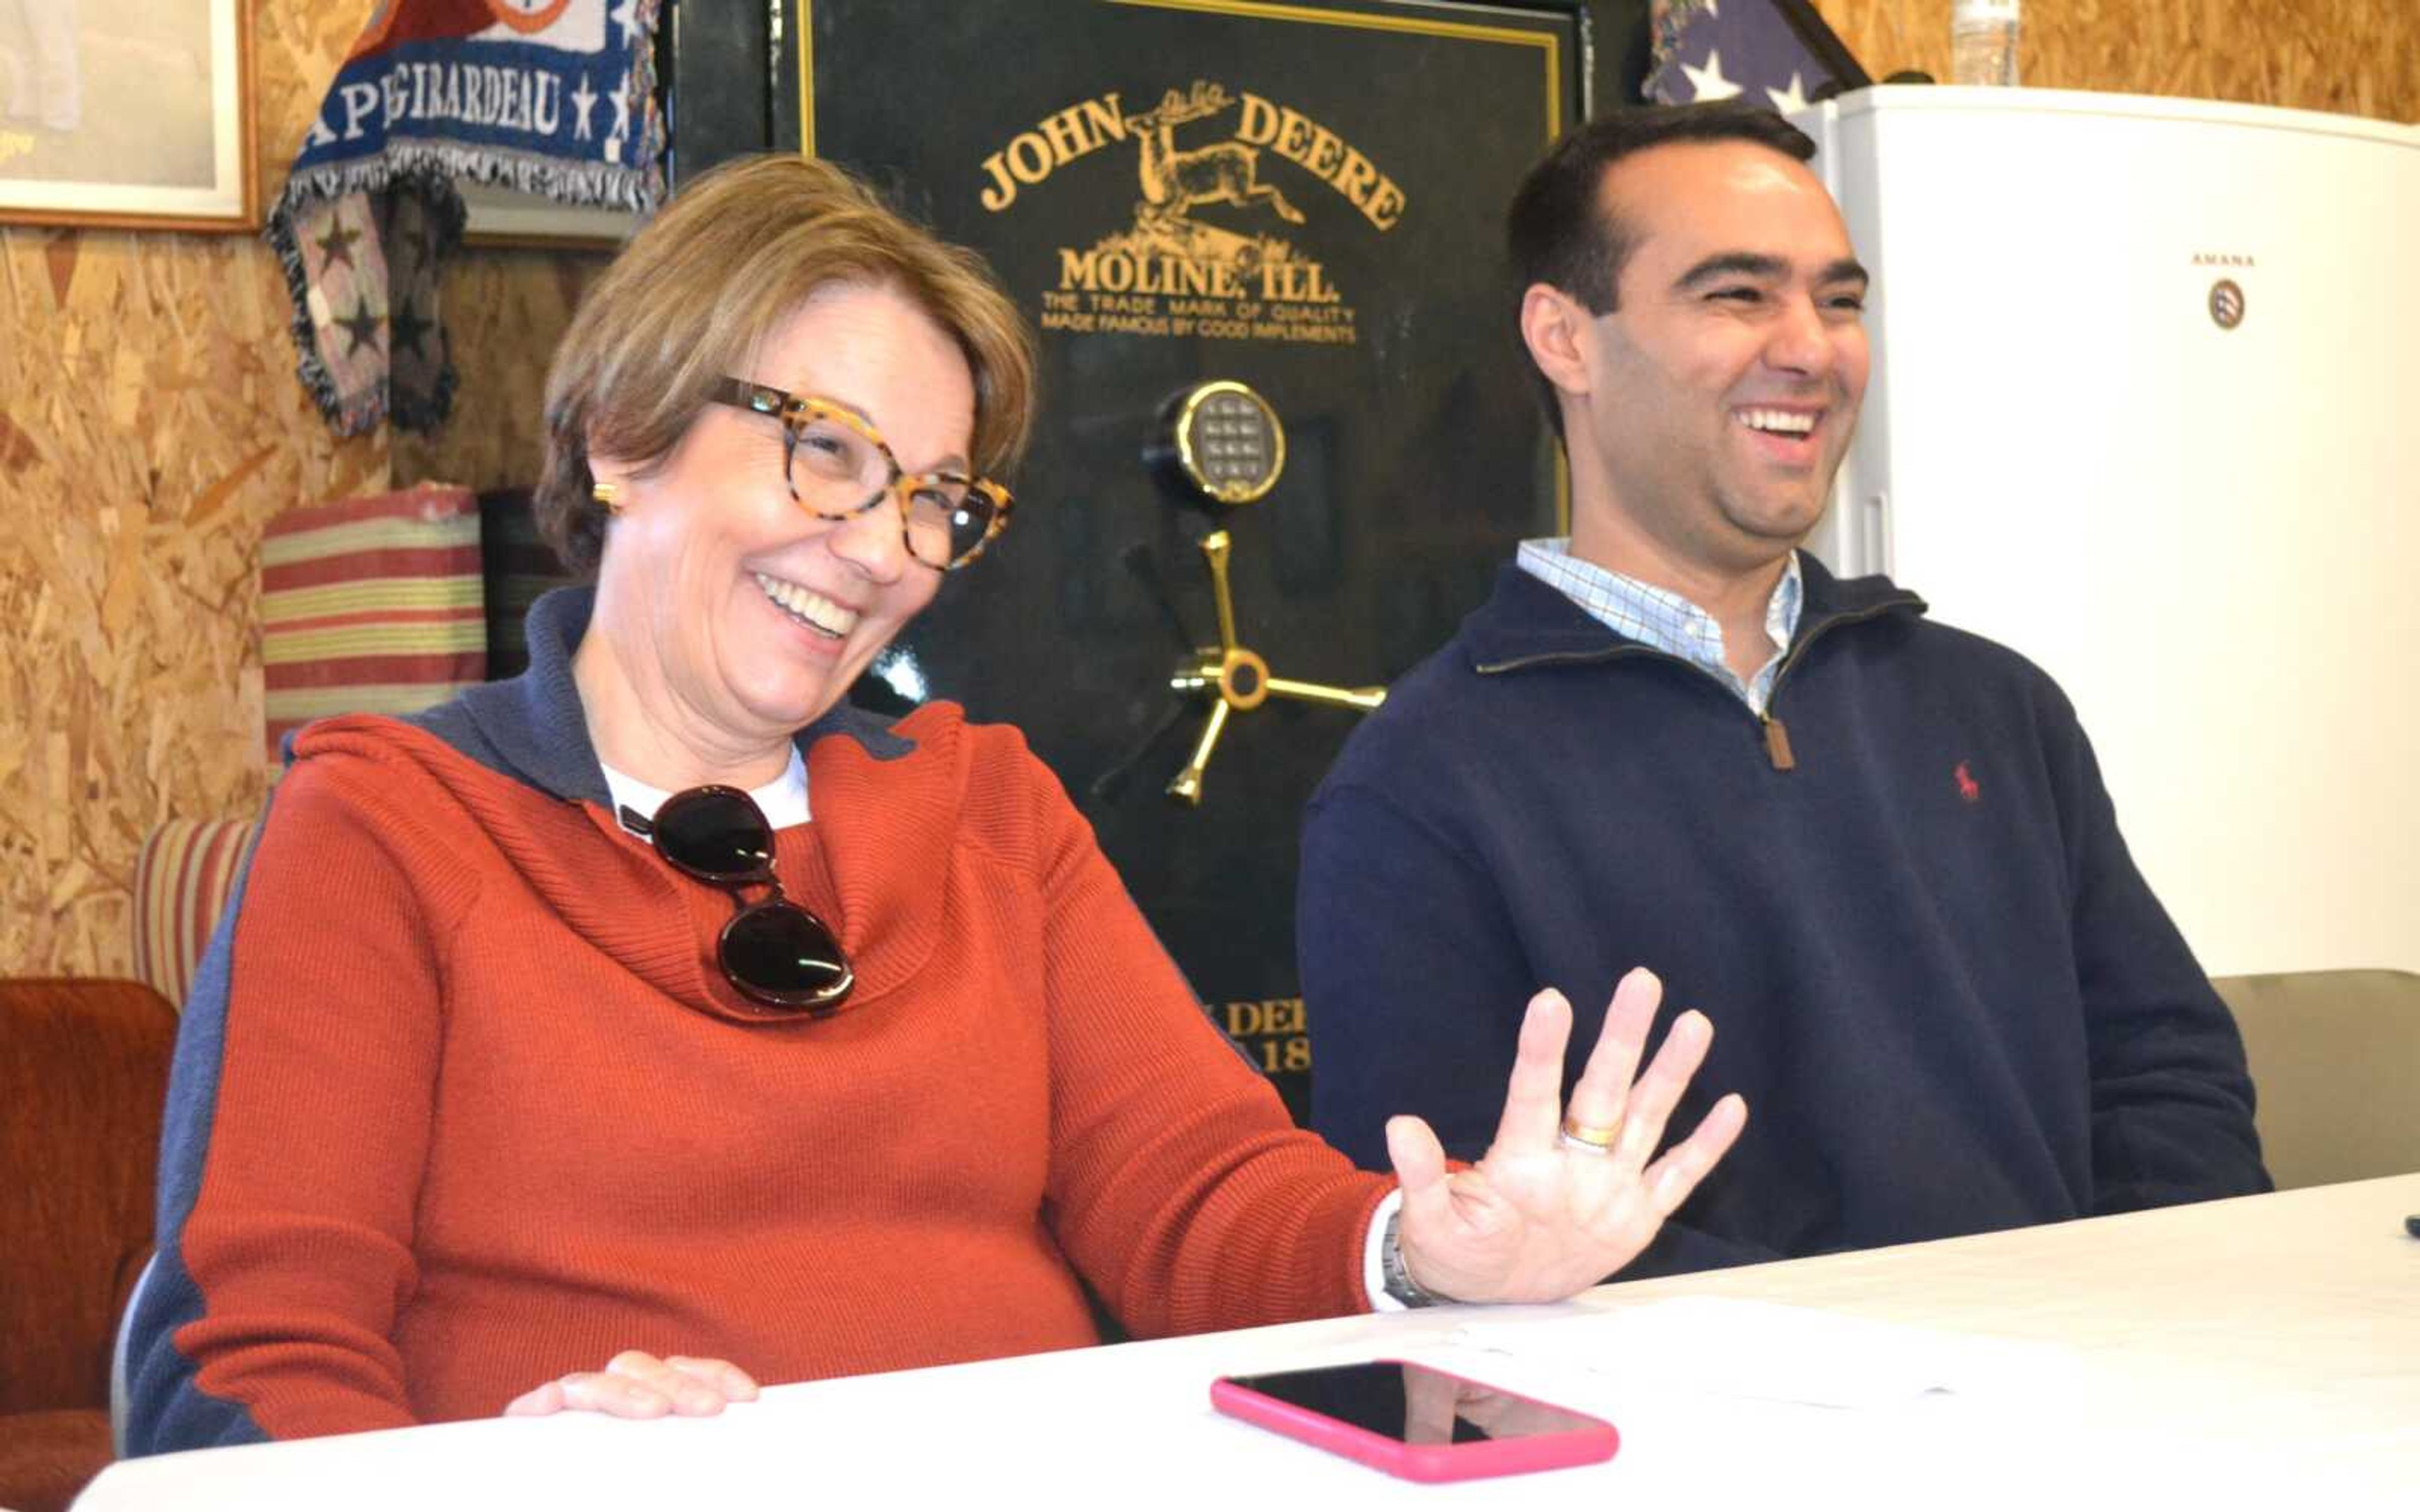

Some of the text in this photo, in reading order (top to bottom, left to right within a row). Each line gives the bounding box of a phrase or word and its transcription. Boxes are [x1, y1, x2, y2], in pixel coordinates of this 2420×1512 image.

[390, 61, 561, 135] GIRARDEAU
[980, 92, 1407, 231] JOHN DEERE
[2191, 253, 2256, 266] AMANA
[1042, 290, 1356, 324] THE TRADE MARK OF QUALITY
[1040, 313, 1095, 332] MADE
[1098, 315, 1168, 336] FAMOUS
[1173, 319, 1196, 338] BY
[1252, 322, 1356, 345] IMPLEMENTS
